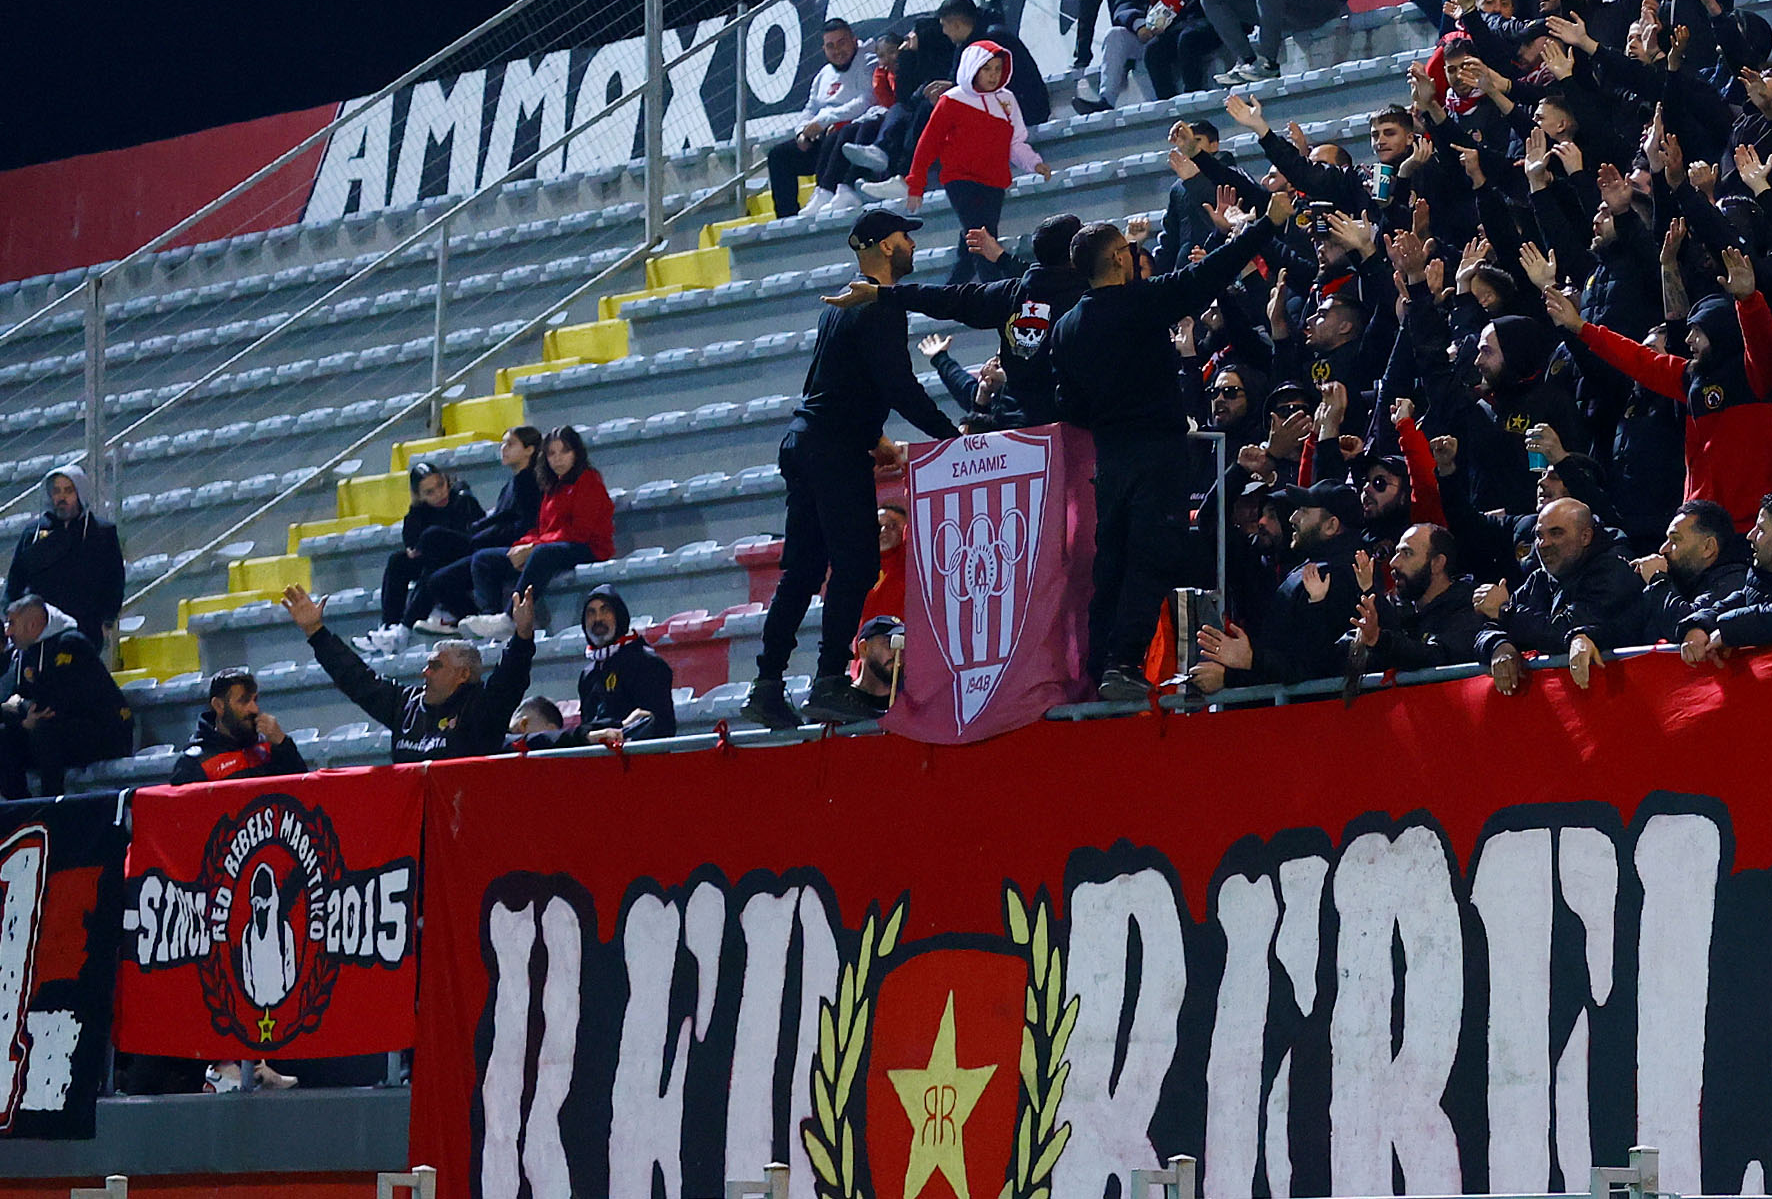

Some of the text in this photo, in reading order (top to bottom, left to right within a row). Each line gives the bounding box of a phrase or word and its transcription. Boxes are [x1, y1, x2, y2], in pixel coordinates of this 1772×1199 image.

[963, 434, 990, 452] ΝΕΑ
[951, 453, 1008, 478] ΣΑΛΑΜΙΣ
[965, 676, 991, 695] 1948
[212, 886, 233, 942] RED
[223, 807, 275, 879] REBELS
[326, 867, 409, 962] 2015
